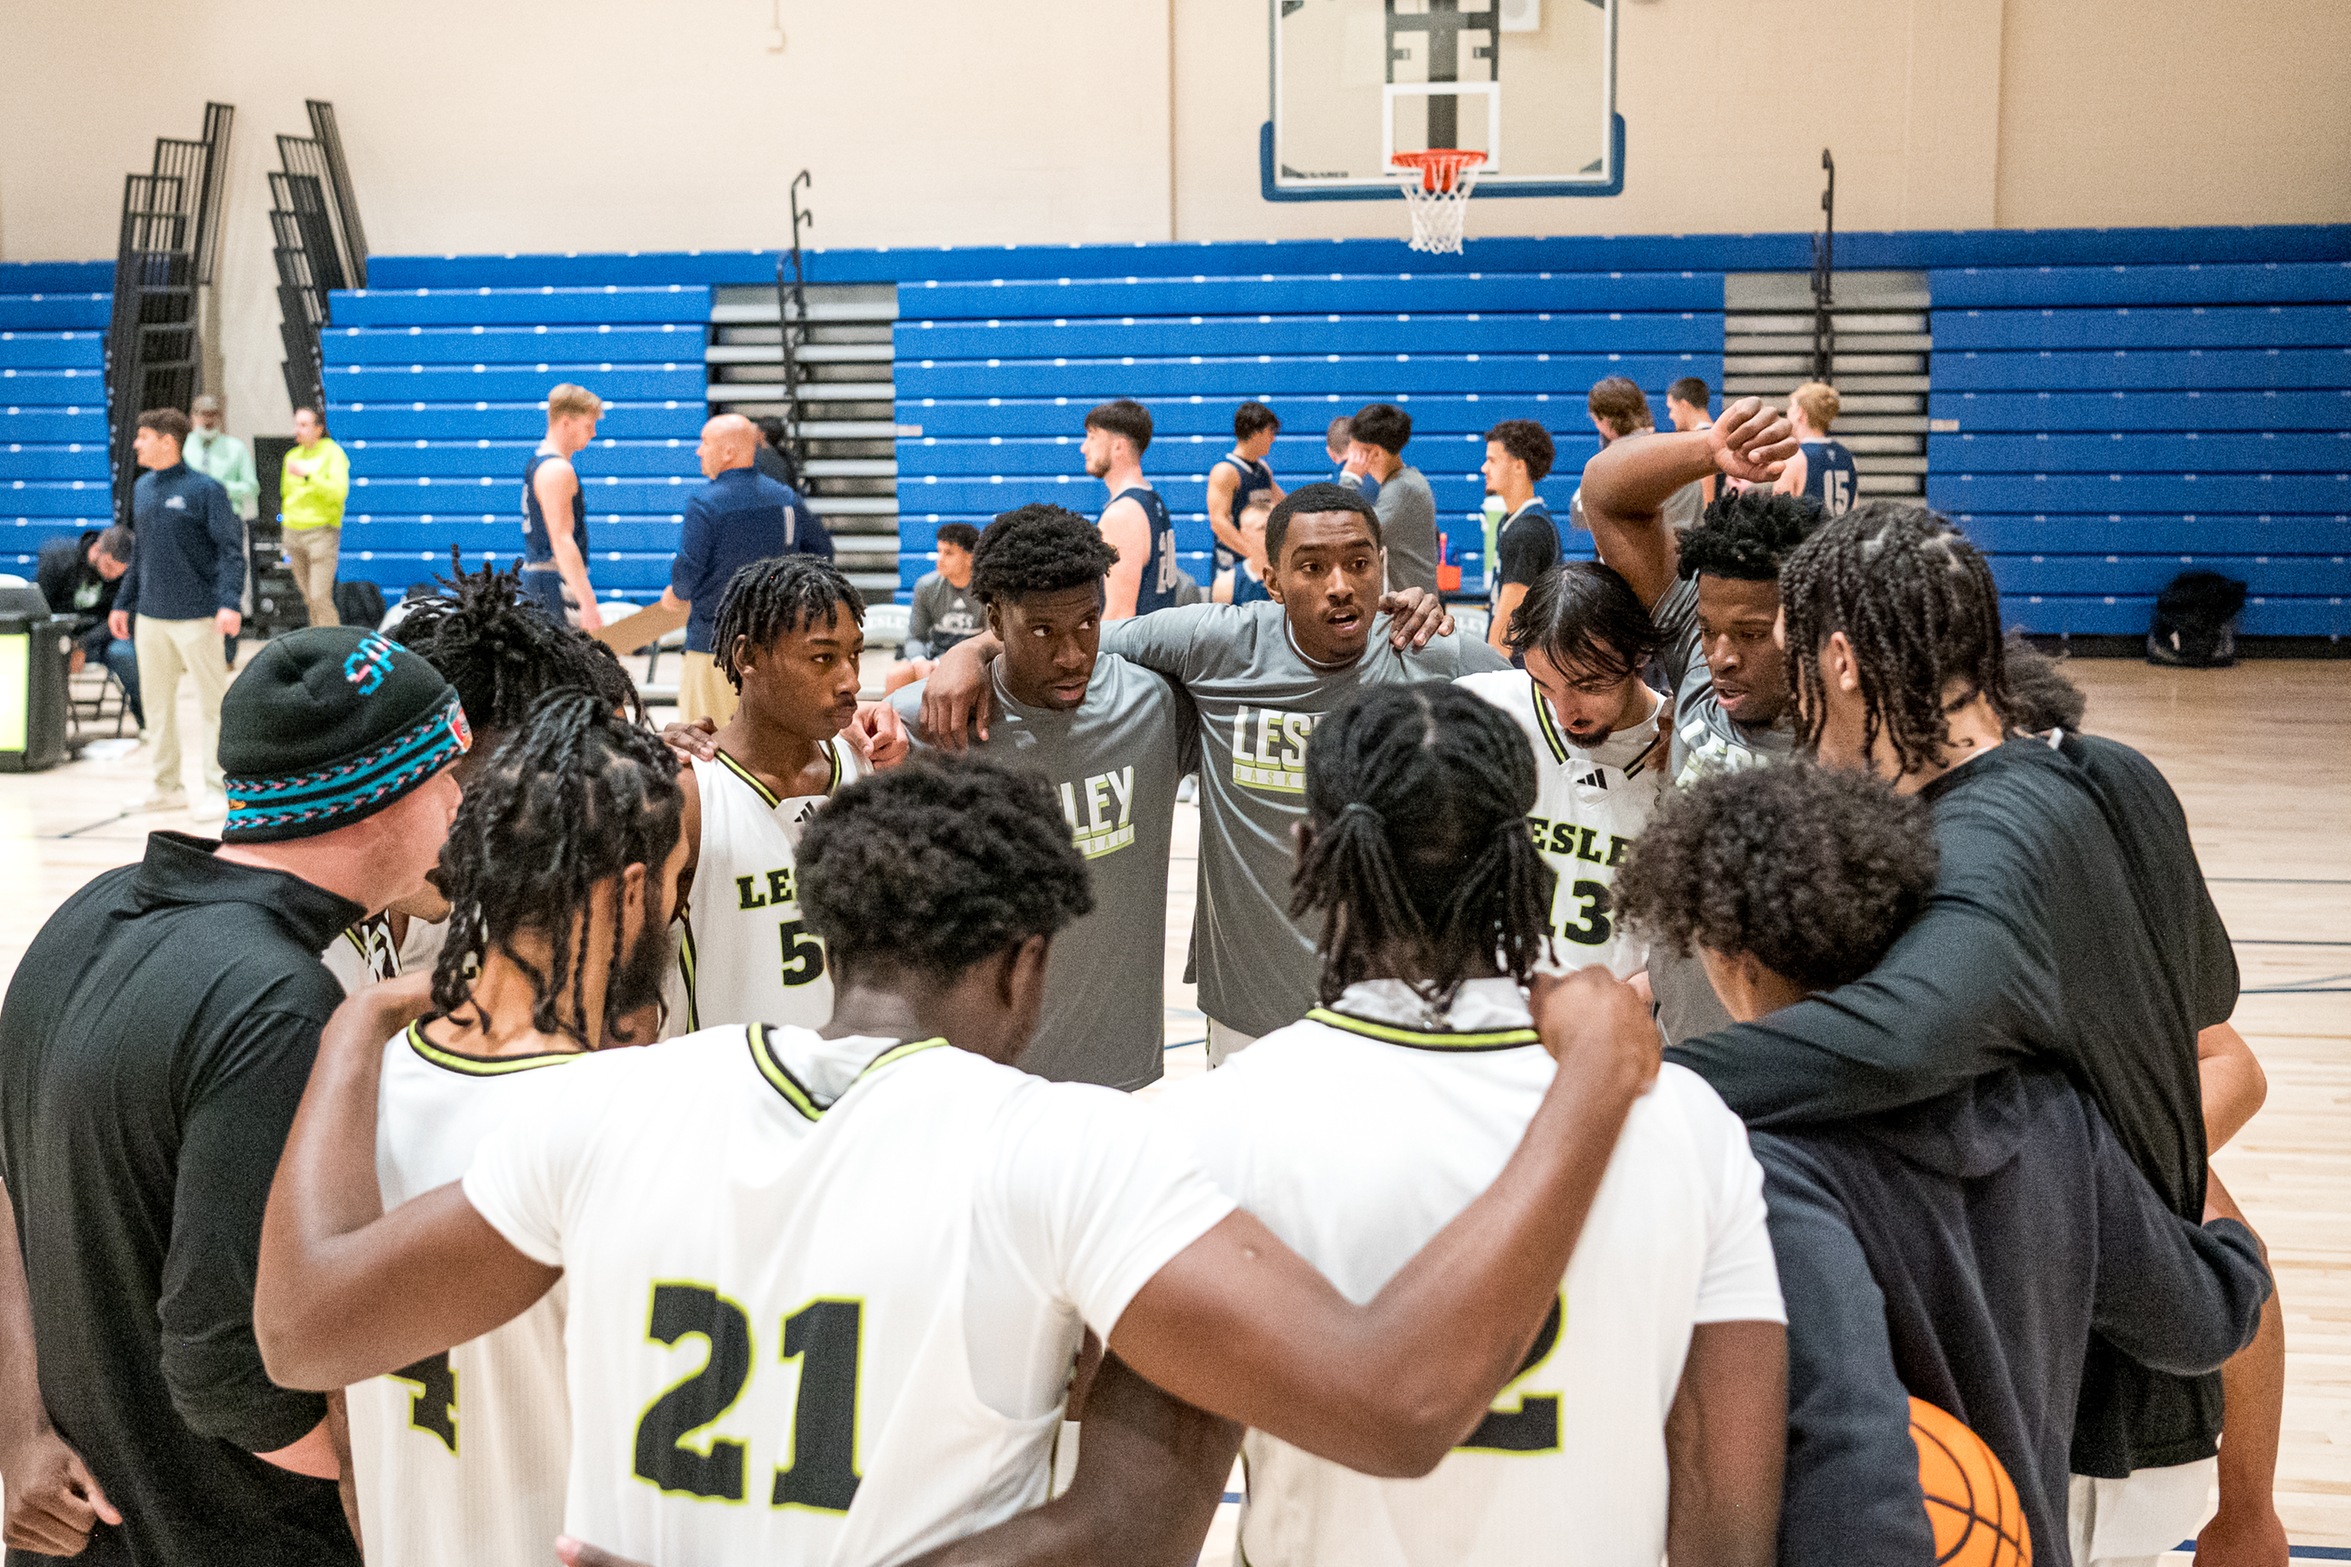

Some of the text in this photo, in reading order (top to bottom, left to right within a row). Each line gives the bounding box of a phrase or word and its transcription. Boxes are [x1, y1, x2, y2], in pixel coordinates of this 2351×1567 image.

[1823, 469, 1850, 516] 15
[1232, 704, 1322, 772] LES
[1053, 765, 1135, 841] LEY
[736, 867, 800, 911] LE
[779, 918, 826, 987] 5
[630, 1278, 865, 1518] 21
